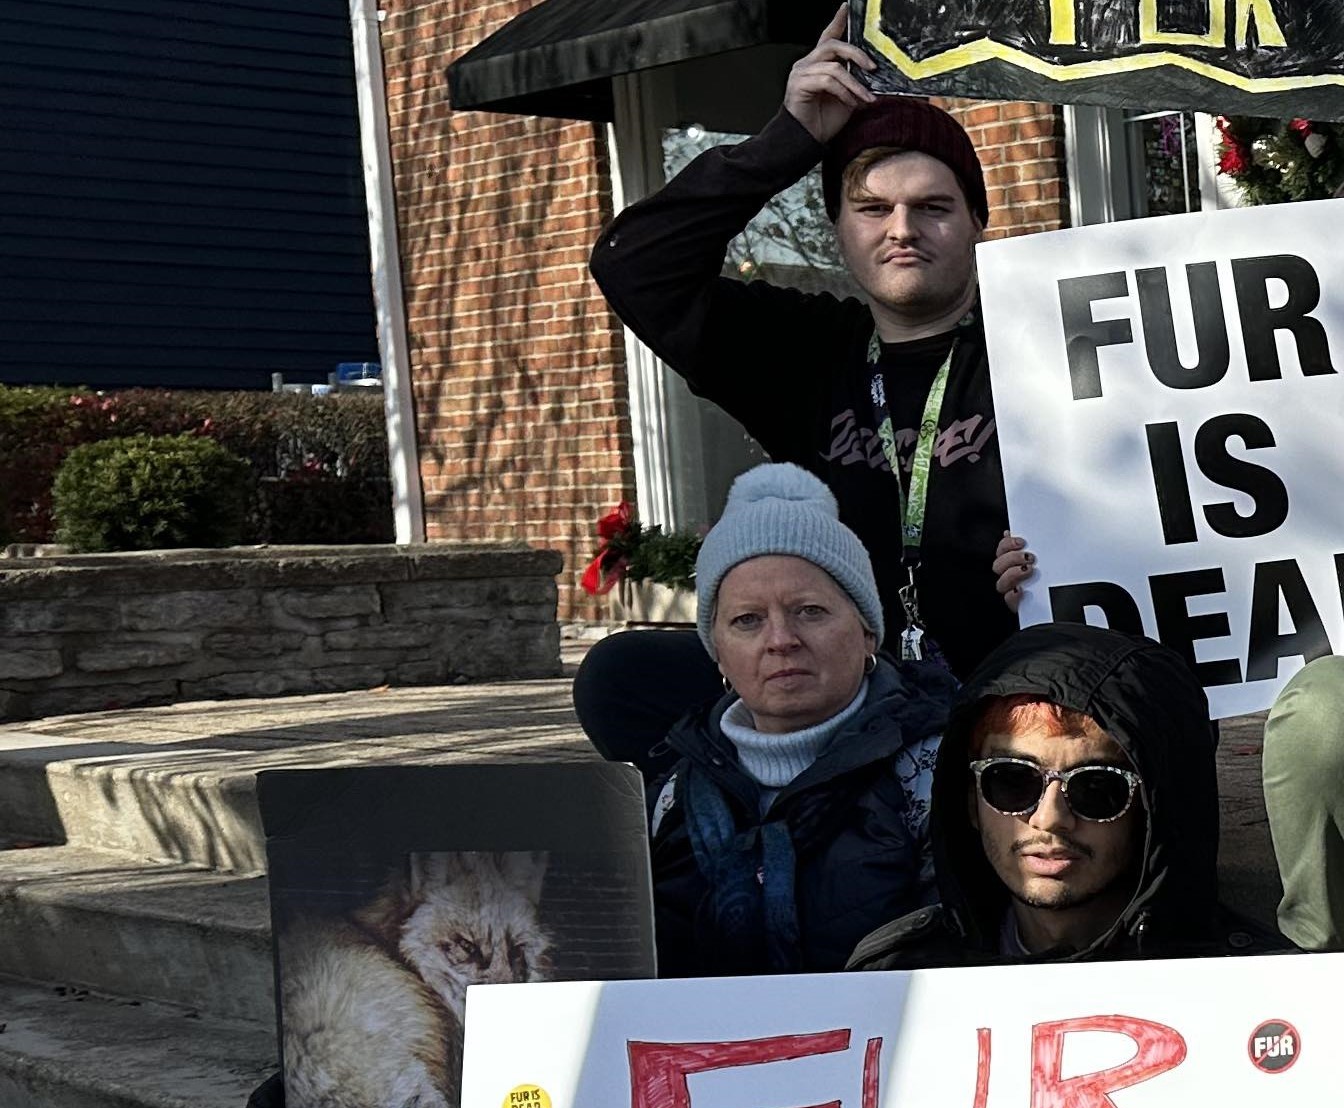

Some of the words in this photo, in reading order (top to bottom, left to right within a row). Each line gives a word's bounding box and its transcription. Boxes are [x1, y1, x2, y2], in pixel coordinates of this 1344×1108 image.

[1058, 254, 1338, 399] FUR
[1146, 413, 1290, 546] IS
[1254, 1034, 1294, 1059] FUR
[510, 1090, 529, 1103] FUR
[532, 1088, 541, 1101] IS
